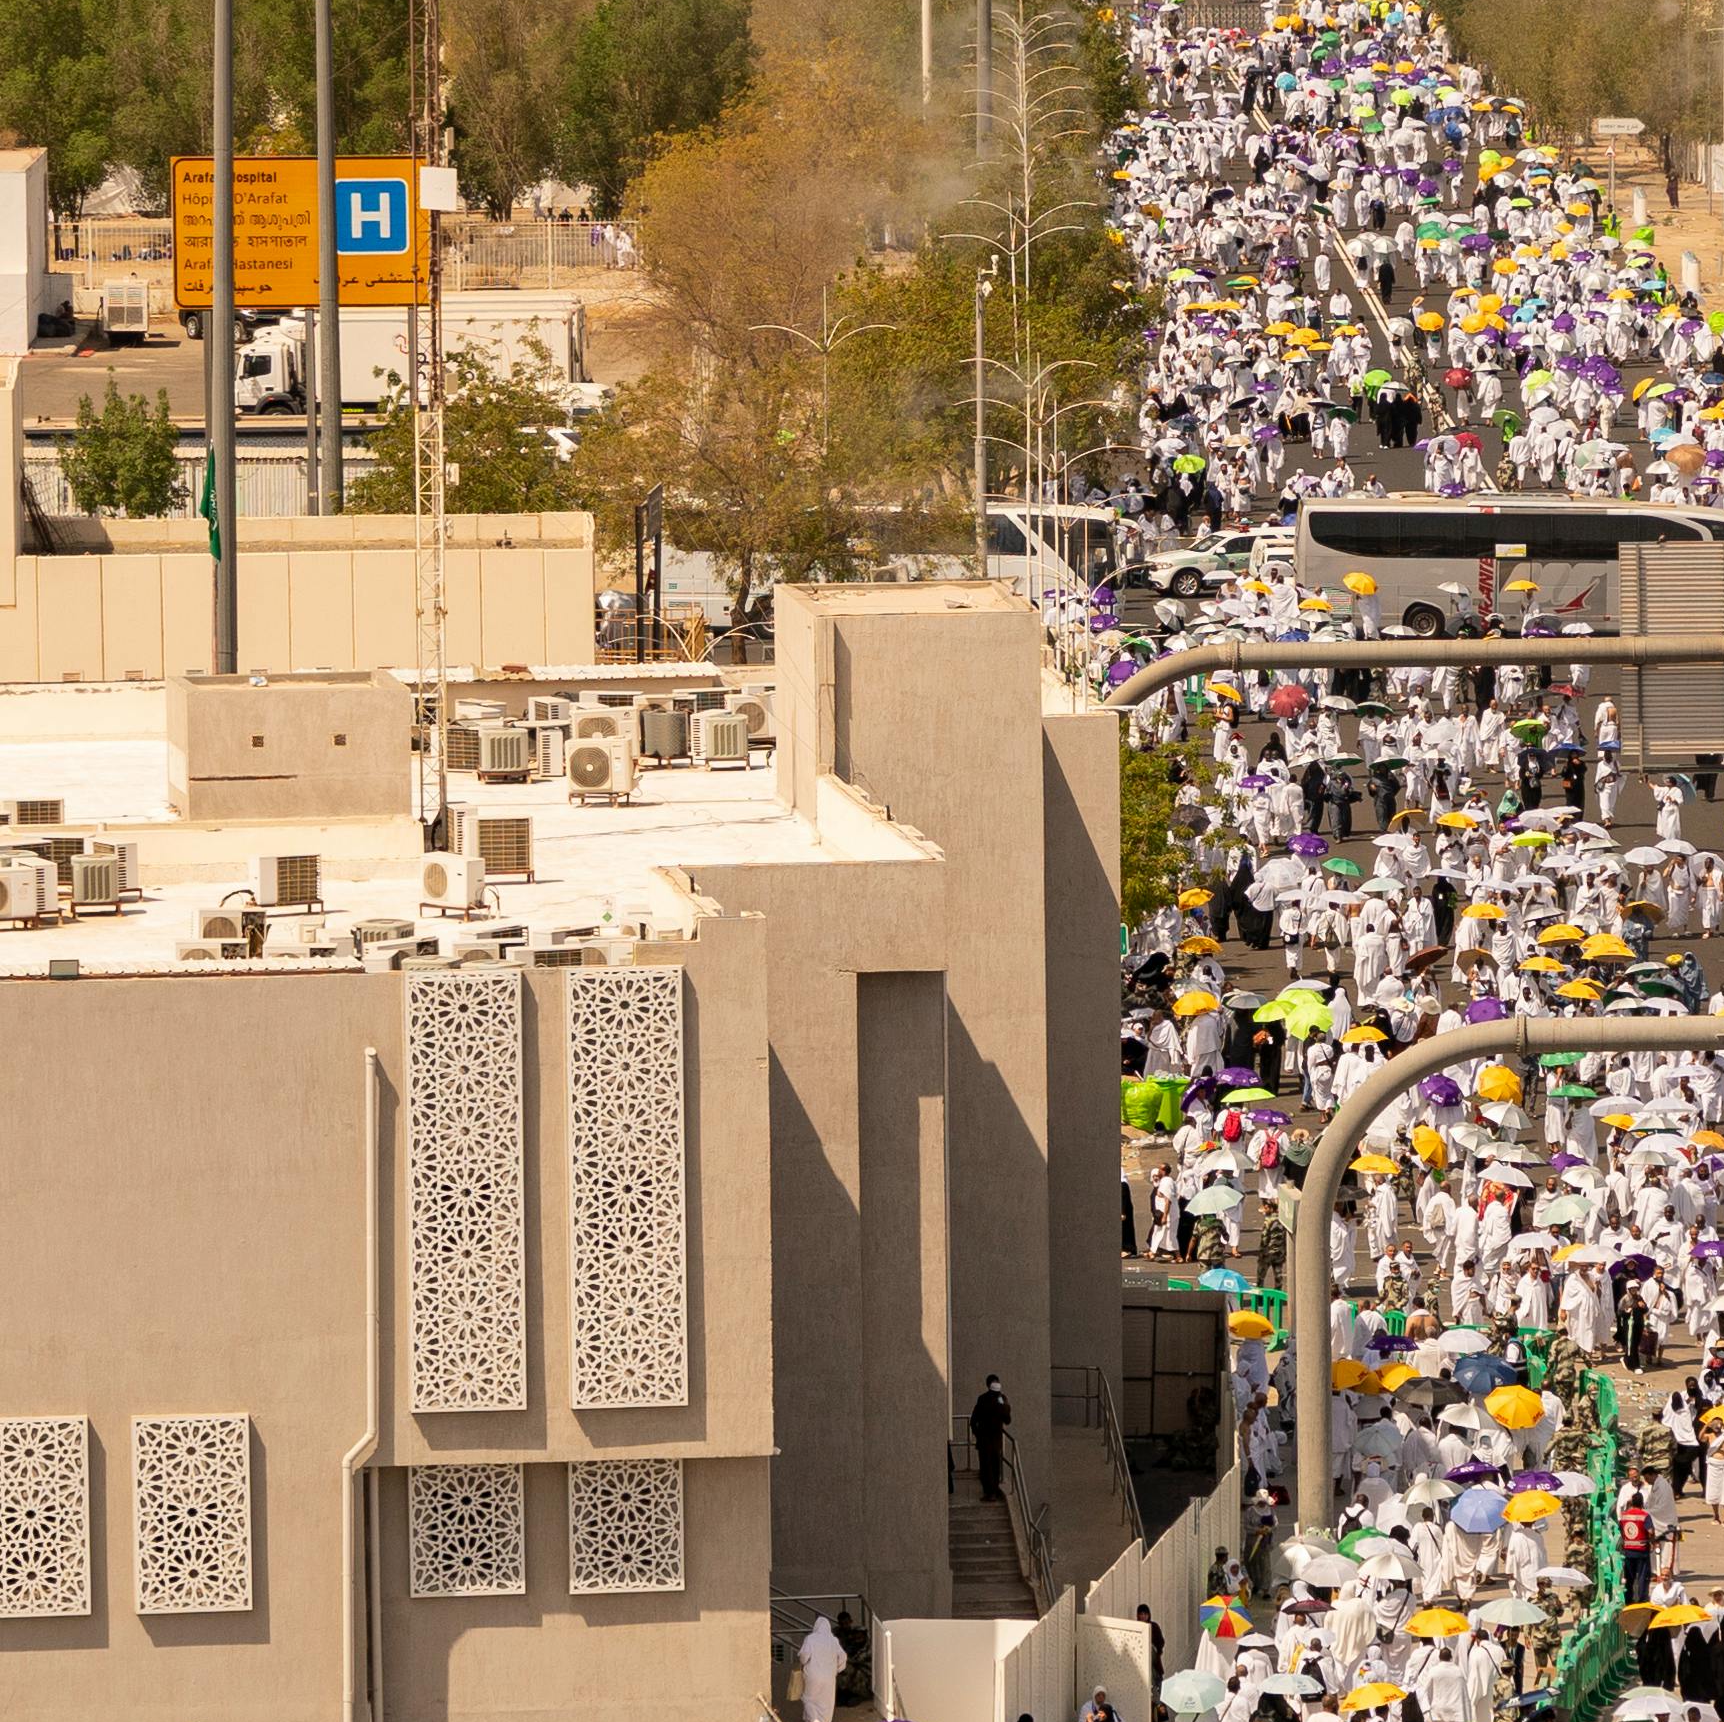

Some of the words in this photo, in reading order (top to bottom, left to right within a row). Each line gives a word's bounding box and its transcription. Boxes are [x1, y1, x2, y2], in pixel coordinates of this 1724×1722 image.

[183, 172, 215, 183] Arafa
[233, 172, 277, 185] ospital
[351, 192, 391, 239] H
